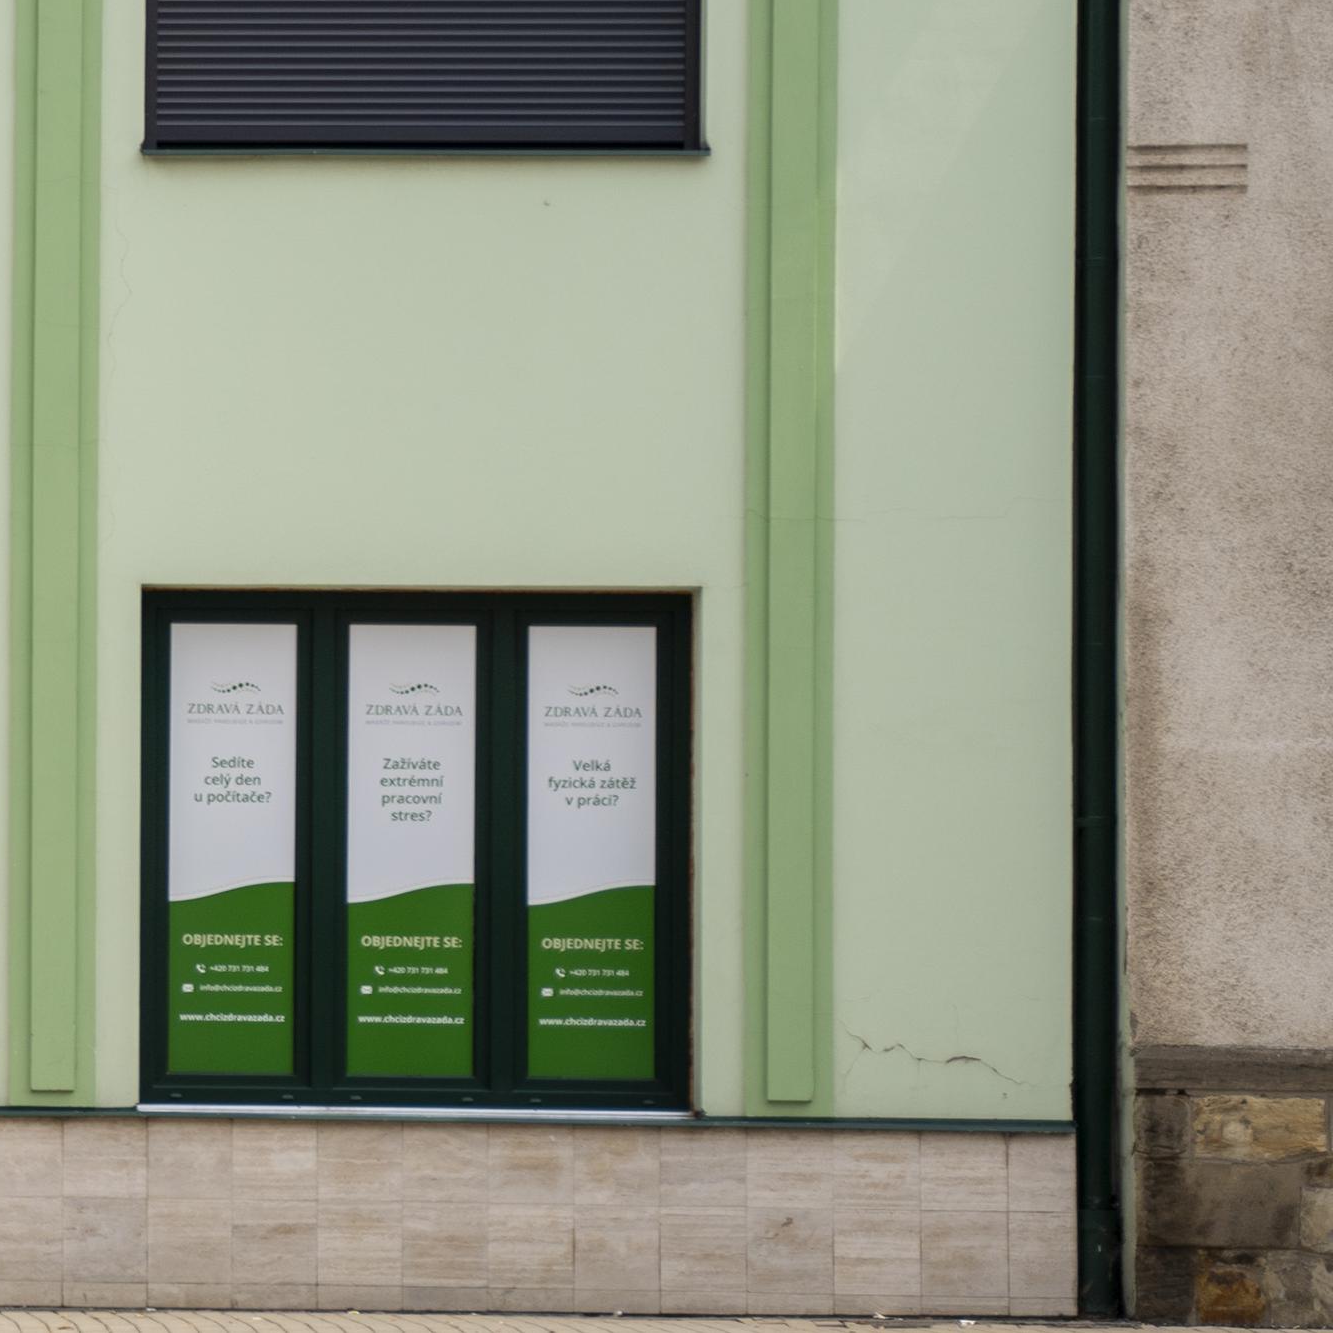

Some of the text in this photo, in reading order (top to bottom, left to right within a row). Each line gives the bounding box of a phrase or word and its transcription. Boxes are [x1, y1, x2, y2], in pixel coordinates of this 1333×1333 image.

[188, 702, 284, 715] ZDRAVÁ ZÁDA
[365, 703, 463, 716] ZDRAVÁ ZÁDA
[545, 705, 642, 718] ZDRAVÁ ZÁDA
[212, 756, 254, 768] Sedíte
[383, 757, 441, 770] Zažíváte
[573, 760, 611, 771] Velká
[205, 773, 261, 788] celý den
[380, 776, 444, 787] extrémní
[548, 777, 636, 791] fyzická zátěž
[194, 791, 272, 805] u počítače?
[382, 793, 443, 807] pracovní
[565, 795, 619, 809] v práci?
[391, 810, 432, 822] stres?
[182, 933, 283, 948] OBJEDNEJTE SE:
[361, 935, 462, 950] OBJEDNEJTE SE:
[541, 938, 644, 952] OBJEDNEJTE SE:
